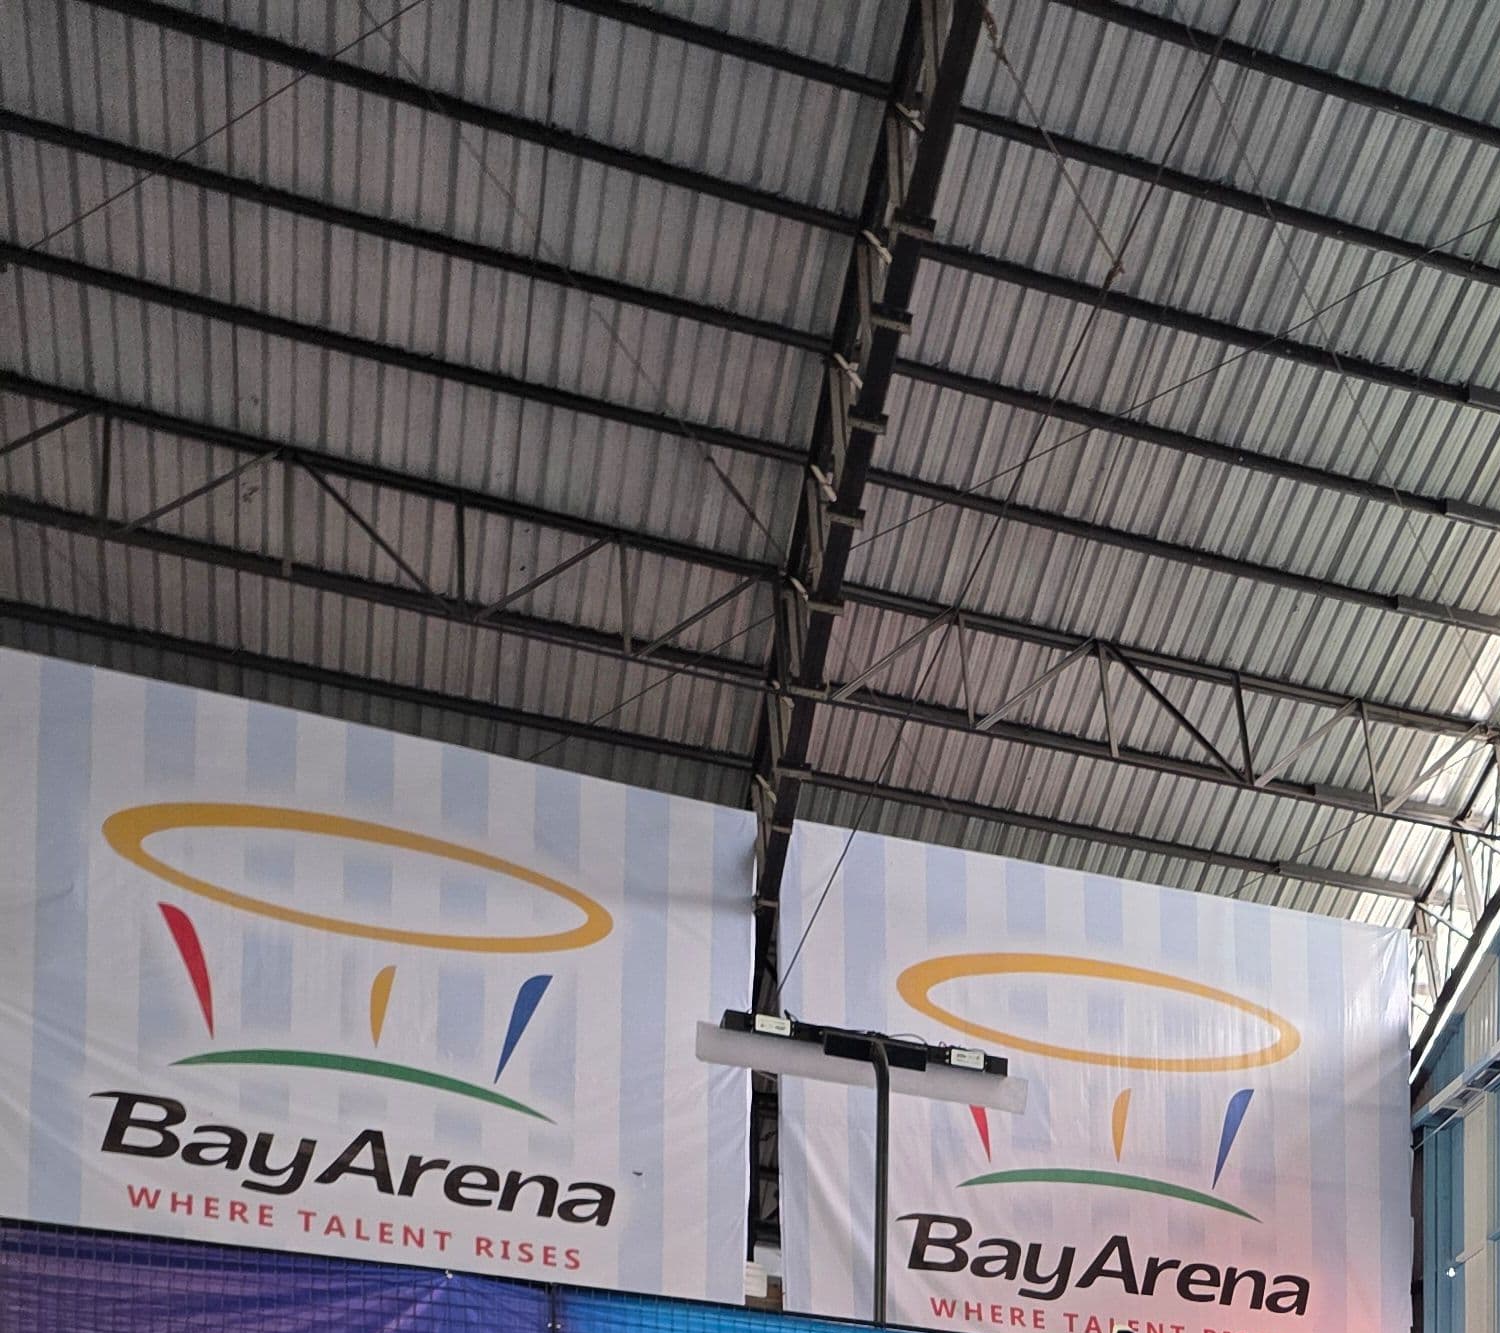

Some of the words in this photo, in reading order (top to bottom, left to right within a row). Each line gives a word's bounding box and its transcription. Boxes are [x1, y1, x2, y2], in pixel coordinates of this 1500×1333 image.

[90, 1091, 616, 1227] BayArena
[127, 1184, 275, 1228] WHERE
[298, 1211, 453, 1251] TALENT
[475, 1234, 582, 1270] RISES
[895, 1212, 1310, 1316] BayArena
[930, 1297, 1046, 1330] WHERE
